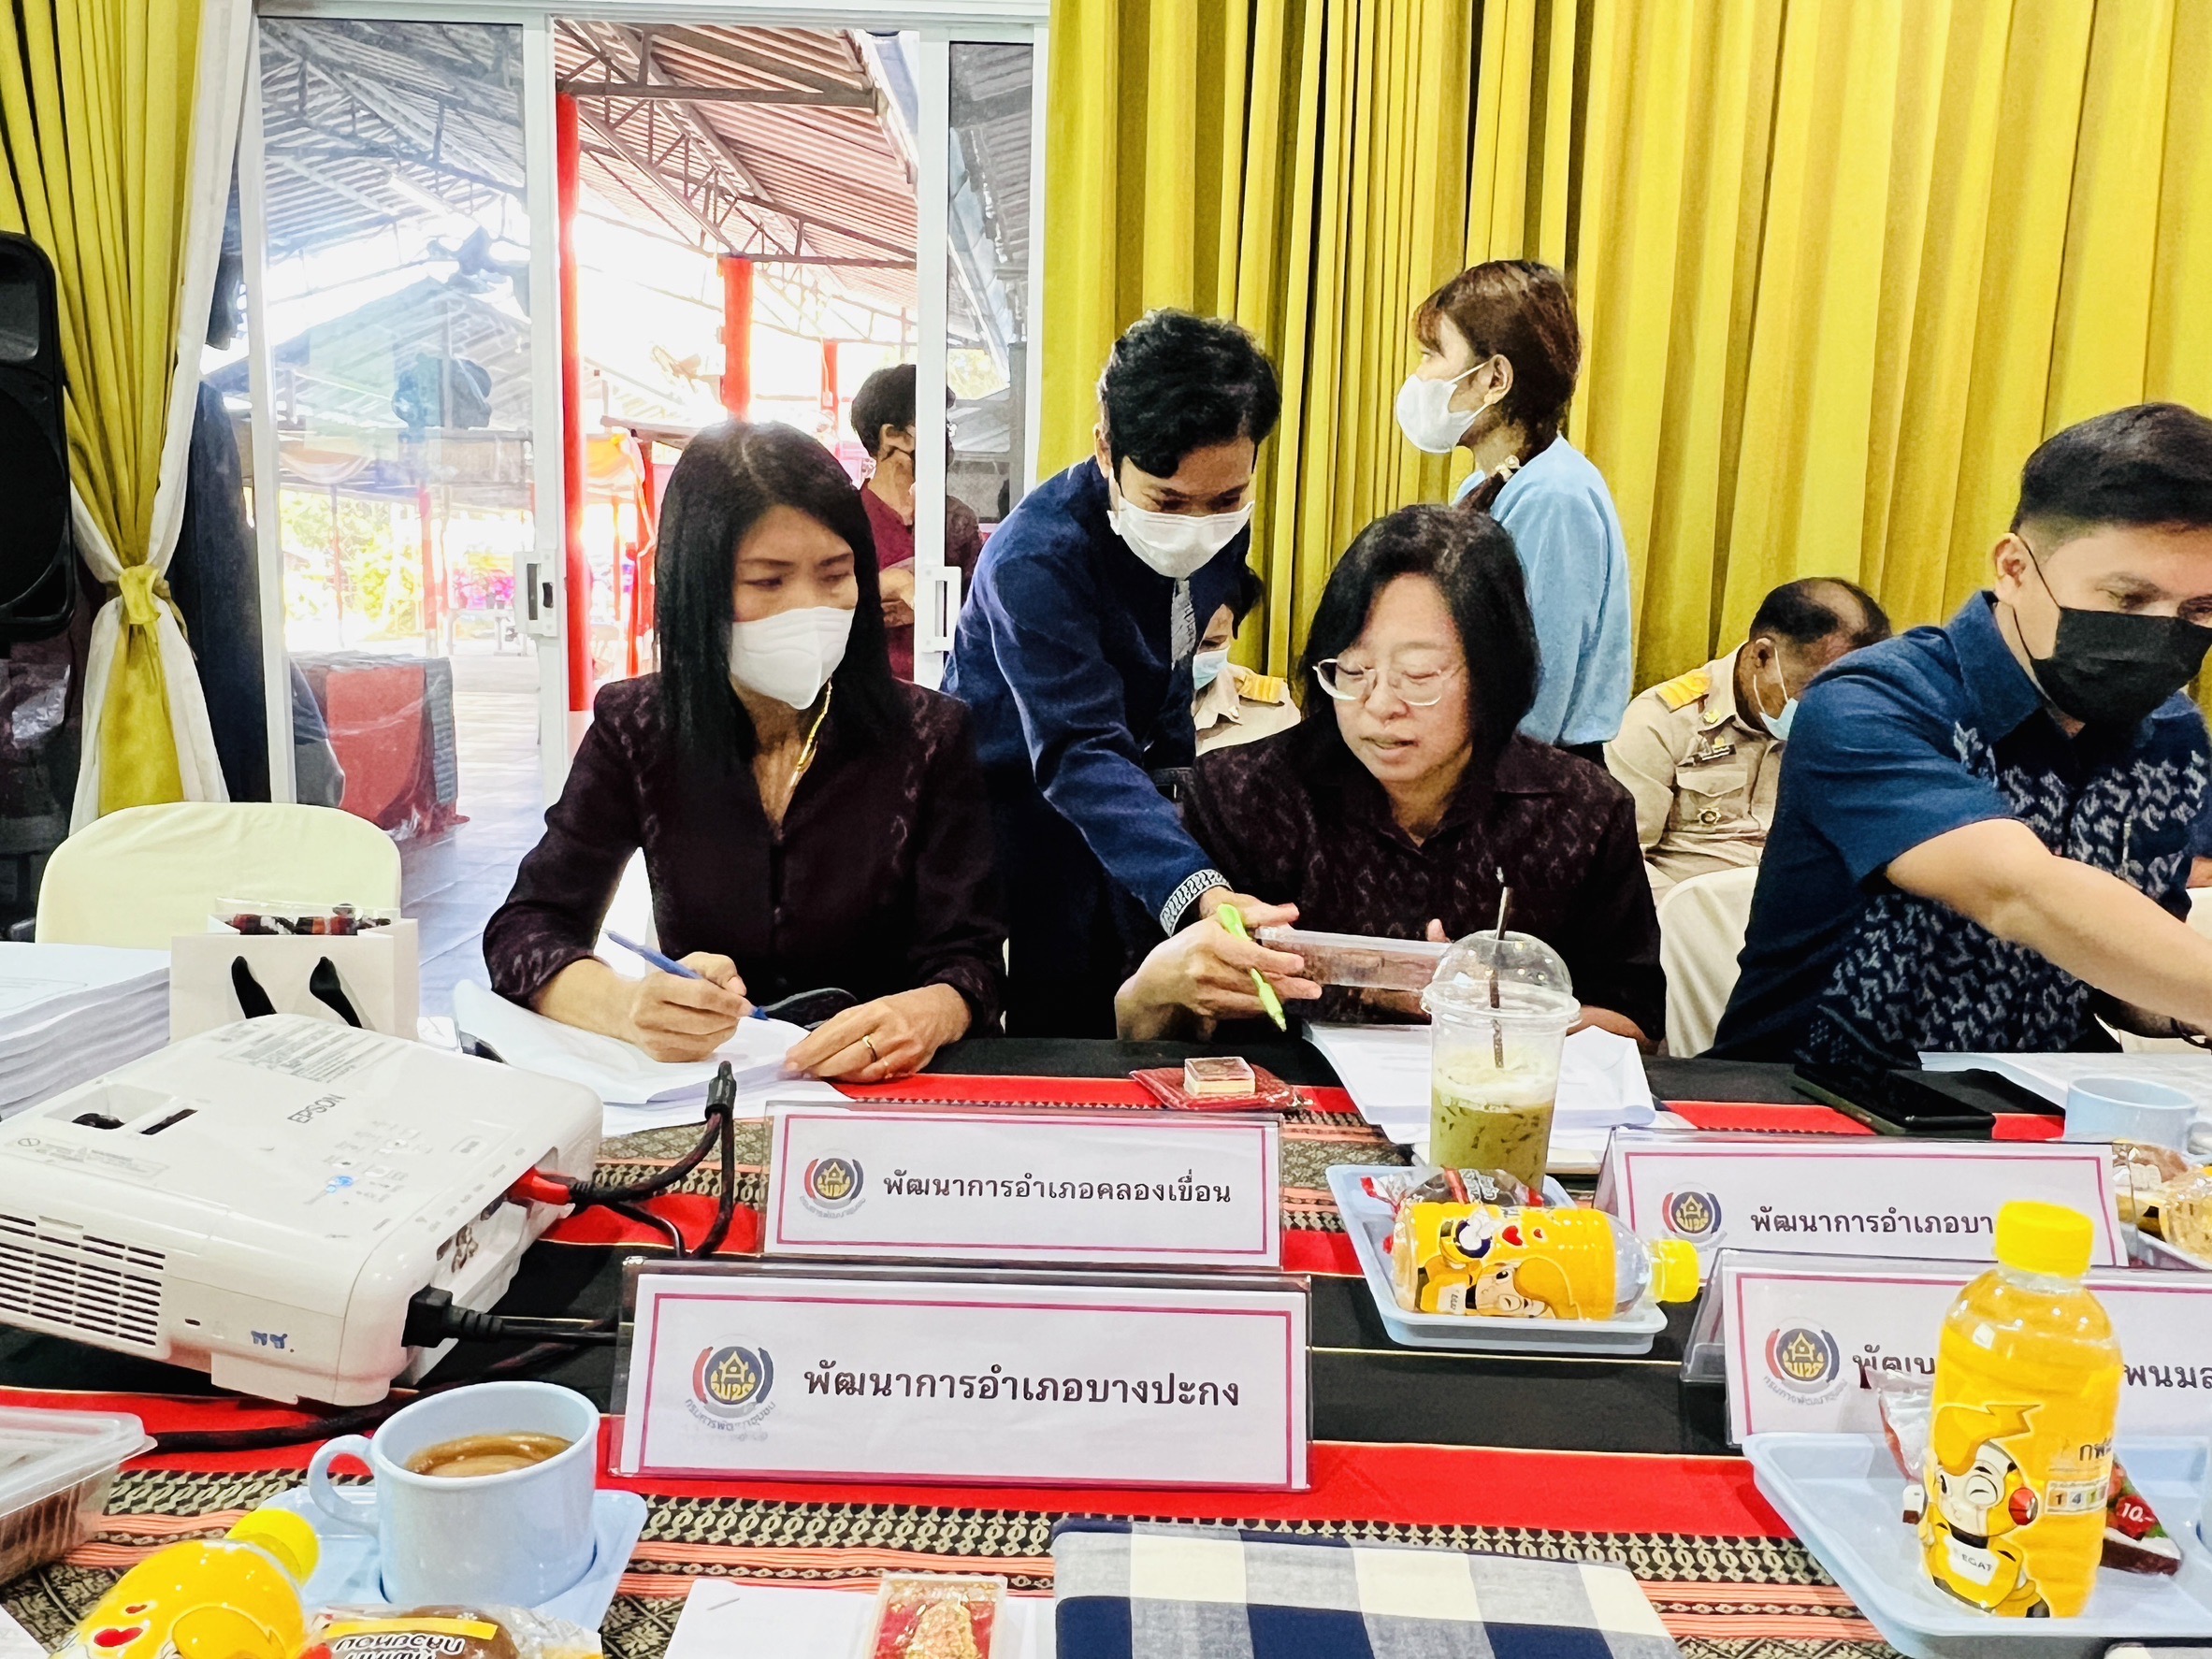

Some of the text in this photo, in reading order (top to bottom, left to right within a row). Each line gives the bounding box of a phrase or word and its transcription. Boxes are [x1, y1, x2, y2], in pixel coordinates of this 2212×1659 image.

[287, 1093, 346, 1124] EPSON
[883, 1168, 1232, 1204] พัฒนาการอำเภอคลองเขื่อน
[803, 1359, 1240, 1407] พัฒนาการอำเภอบางปะกง
